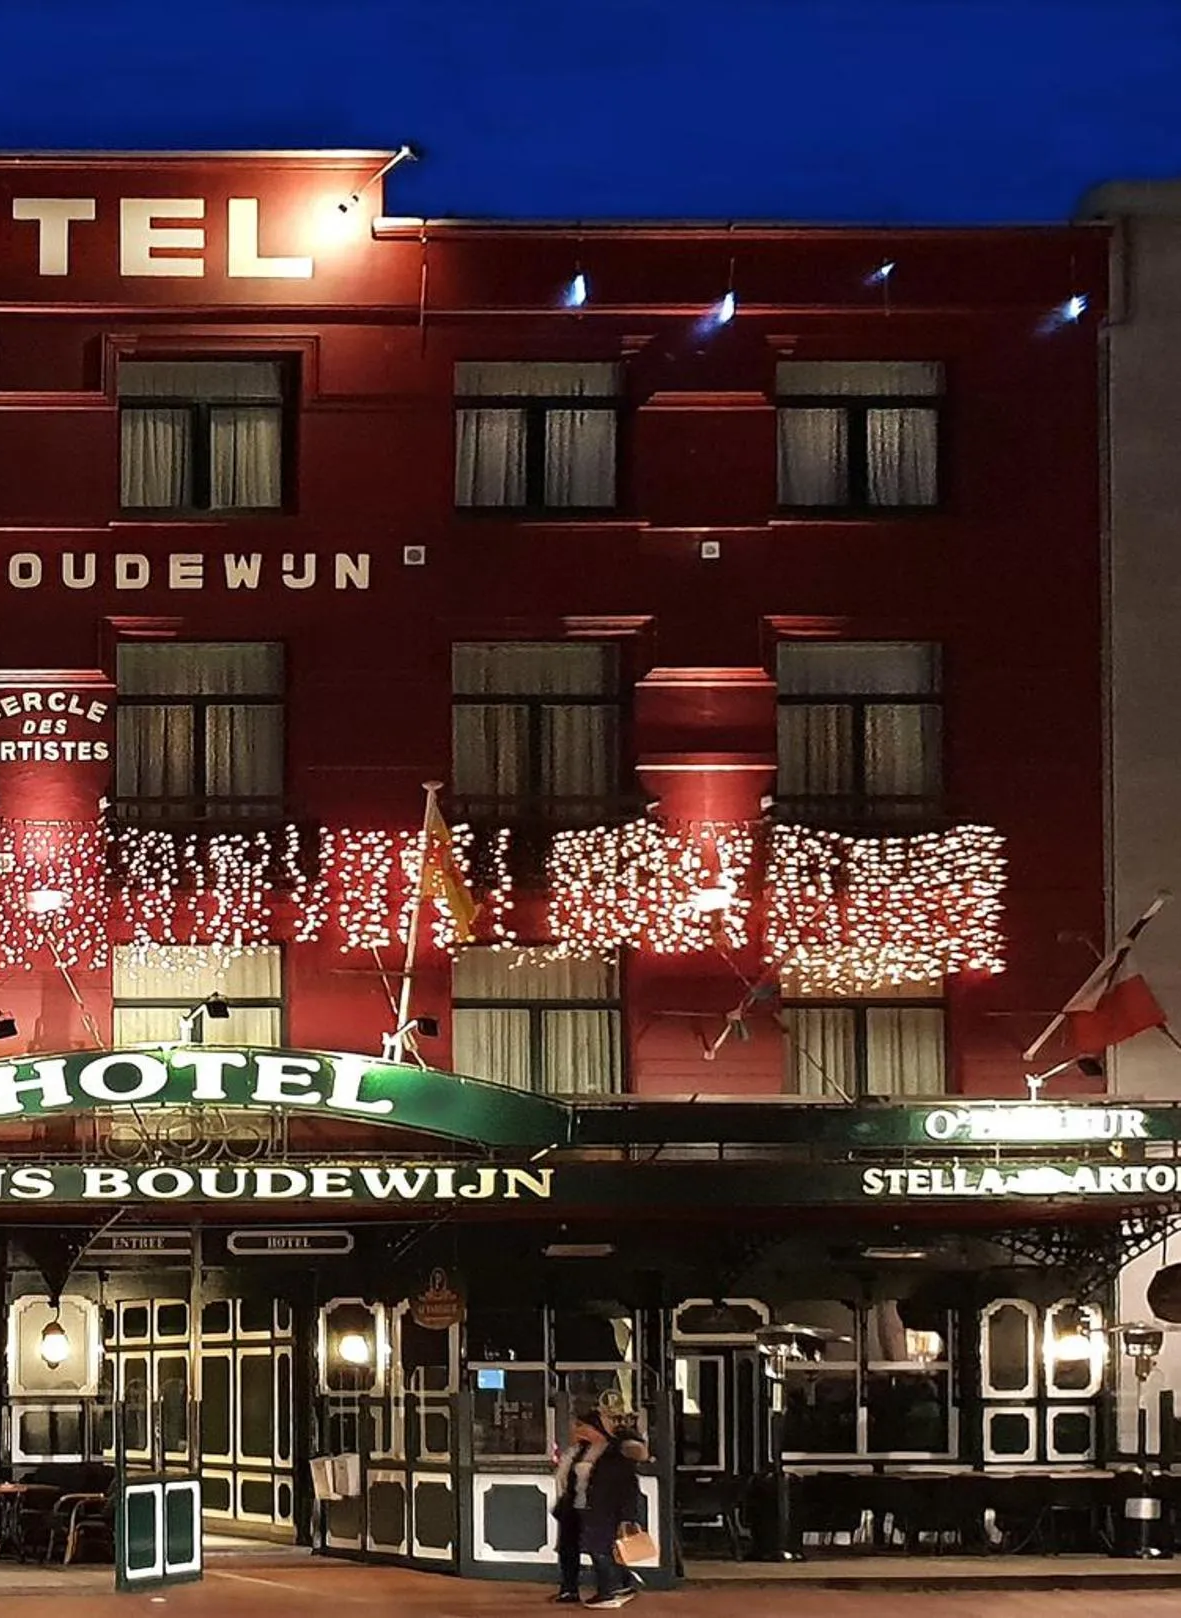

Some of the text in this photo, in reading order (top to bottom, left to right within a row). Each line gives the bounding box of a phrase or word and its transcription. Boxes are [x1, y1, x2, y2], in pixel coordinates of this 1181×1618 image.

[23, 718, 68, 735] DES
[81, 1167, 555, 1200] BOUDEWIJN
[862, 1166, 1008, 1196] STELLA
[268, 1236, 312, 1249] HOTEL
